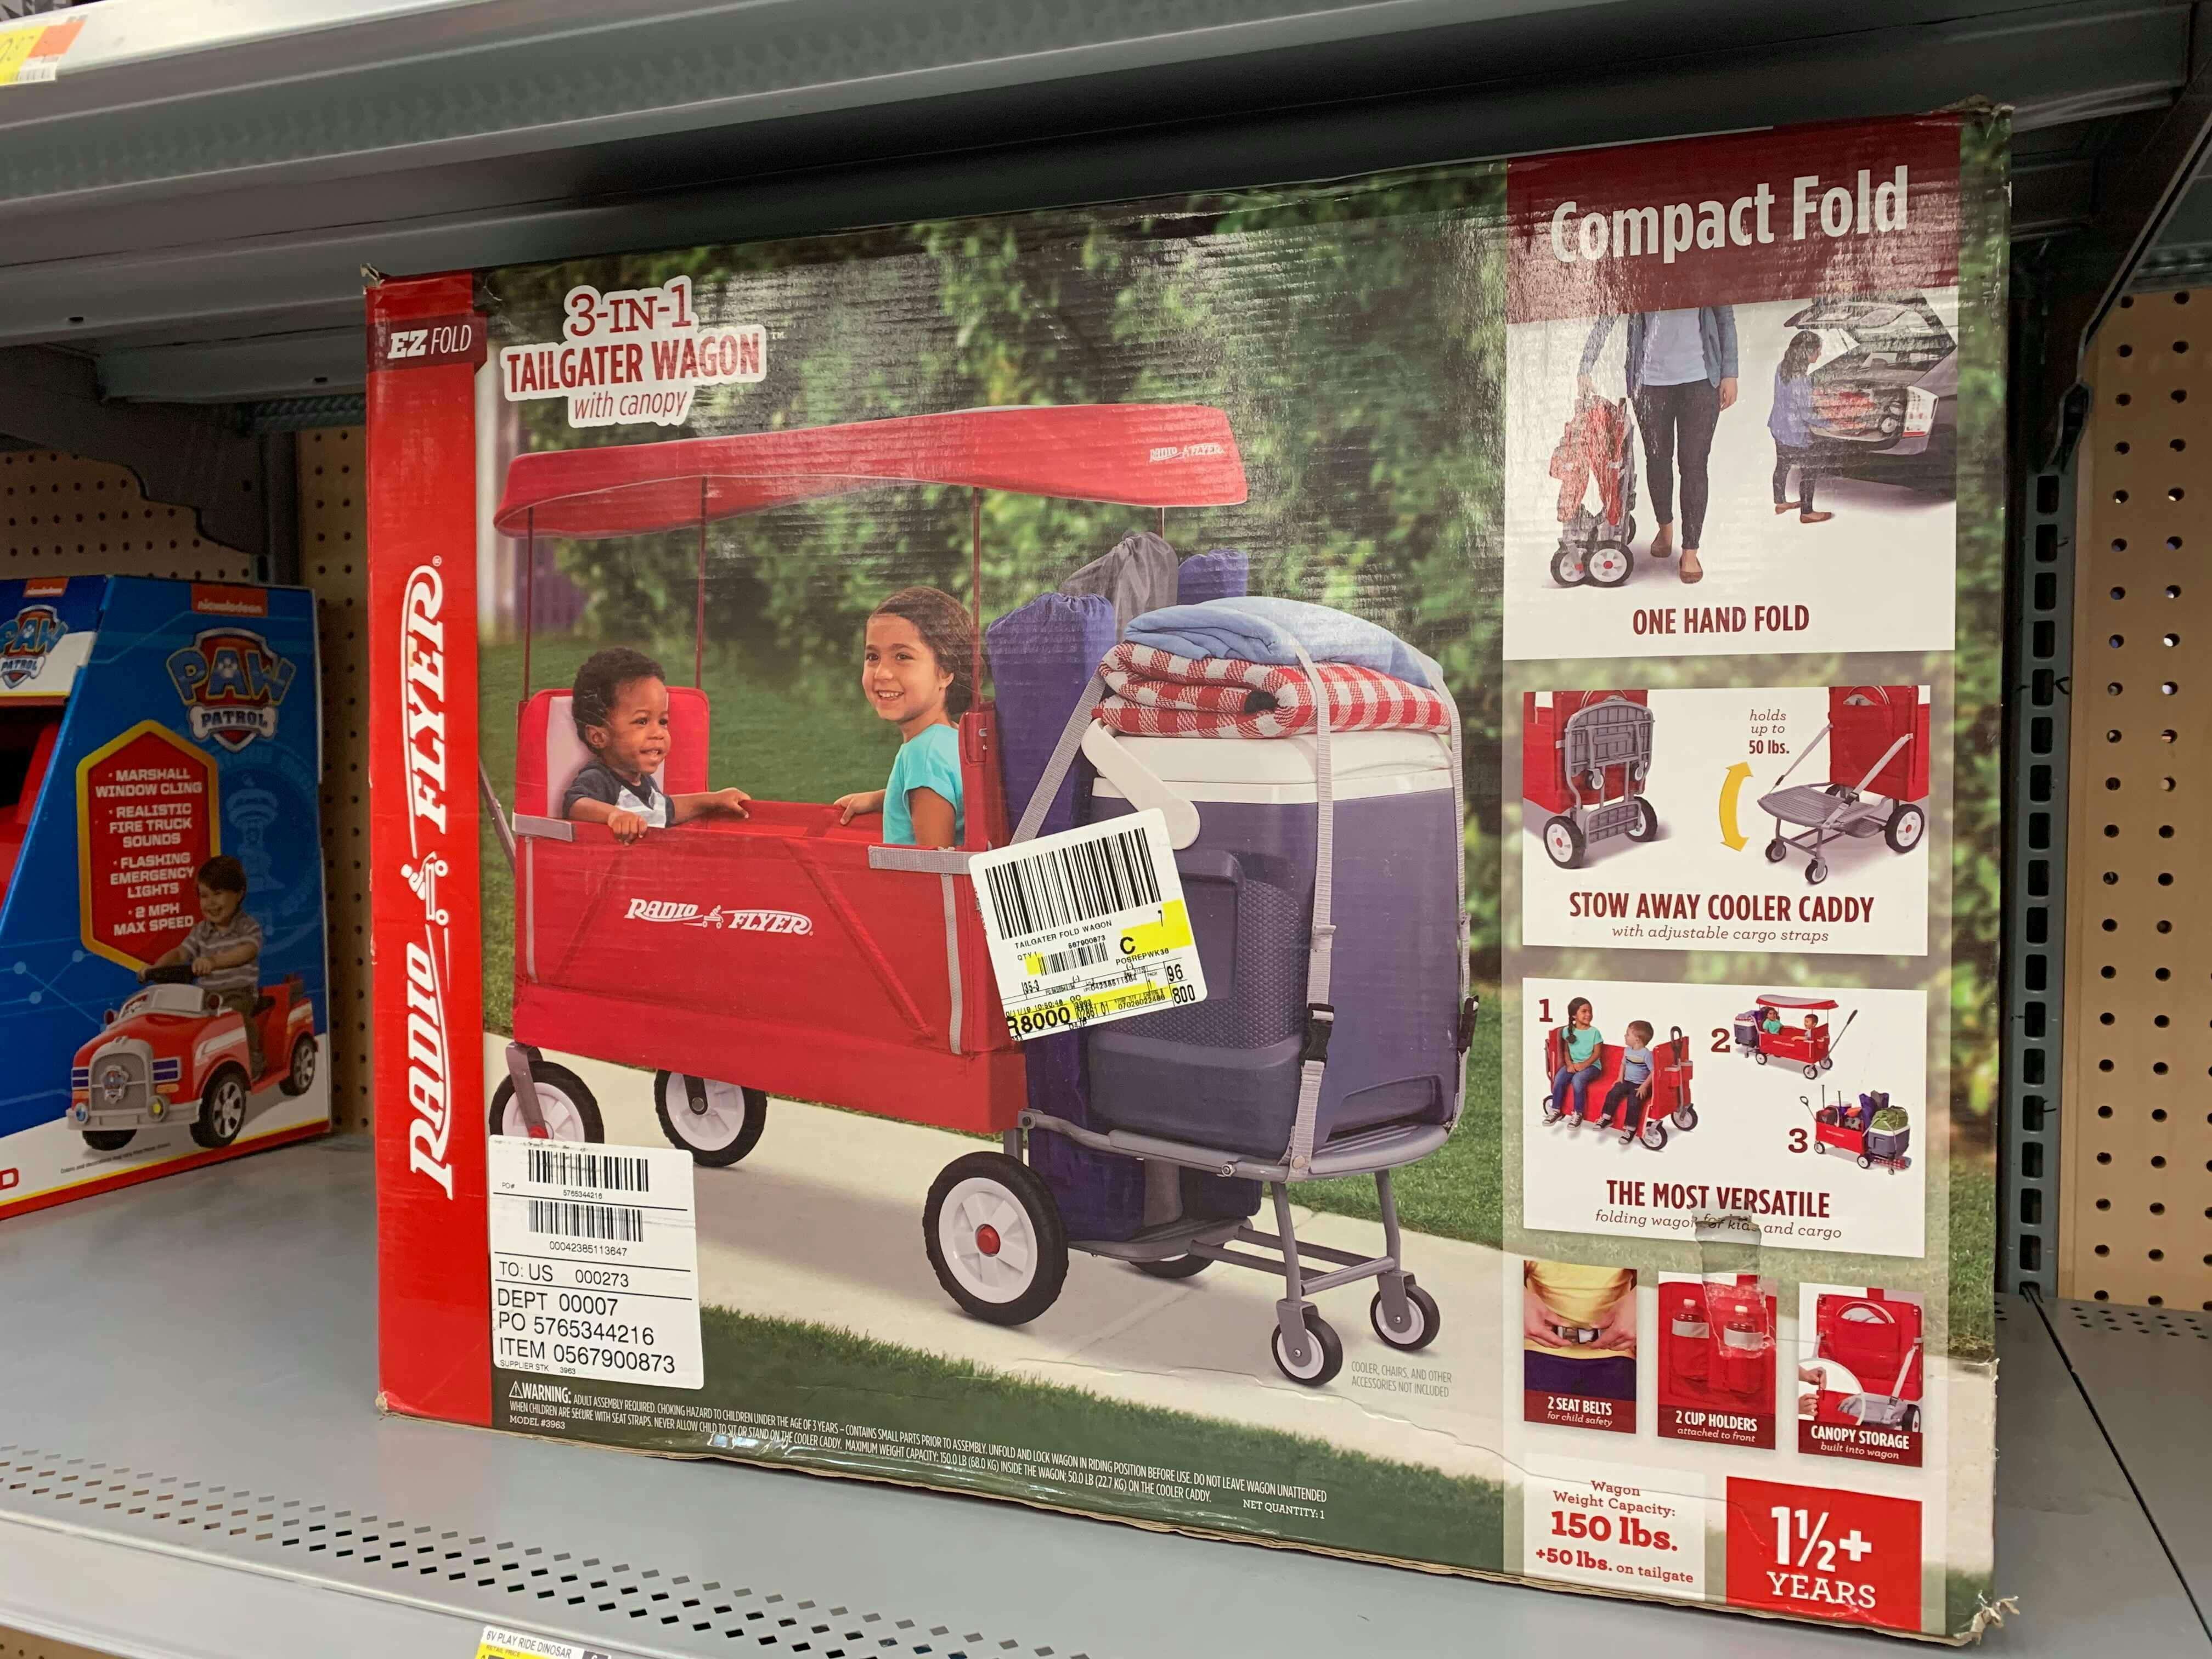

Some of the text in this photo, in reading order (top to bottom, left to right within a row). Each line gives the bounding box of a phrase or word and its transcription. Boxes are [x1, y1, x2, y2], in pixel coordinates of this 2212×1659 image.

[1550, 165, 1908, 264] Compact Fold
[571, 284, 692, 337] 3-IN-1
[387, 324, 471, 359] EZ FOLD
[507, 333, 760, 393] TAILGATER WAGON
[574, 390, 687, 426] with canopy
[1633, 605, 1809, 635] ONE HAND FOLD
[1, 657, 38, 673] PATROL
[166, 646, 296, 706] PAW
[201, 710, 268, 726] PATROL
[1750, 709, 1787, 722] holds
[1751, 723, 1786, 737] up to
[1749, 739, 1790, 755] 50 lbs.
[116, 768, 190, 781] MARSHALL
[95, 782, 202, 798] WINDOW CLING
[116, 803, 192, 819] REALISTIC
[109, 817, 193, 834] FIRE TRUCK
[123, 833, 181, 848] SOUNDS
[120, 852, 190, 870] FLASHING
[110, 866, 194, 885] EMERGENCY
[400, 563, 453, 1201] RADIO FLYER
[127, 882, 179, 899] LIGHTS
[136, 902, 179, 918] 2 MPH
[624, 898, 812, 935] RADIO FLYER
[1570, 892, 1875, 923] STOW AWAY COOLER CADDY
[114, 915, 194, 936] MAX SPEED
[1014, 920, 1112, 949] TAILGATER FOLD WAGON
[1612, 925, 1830, 944] with adjustable cargo straps
[1017, 952, 1032, 961] QTY
[1120, 937, 1136, 955] C
[1167, 963, 1184, 982] 96
[1172, 984, 1196, 1004] 800
[1539, 999, 1554, 1023] 1
[1710, 1028, 1731, 1053] 2
[1788, 1128, 1808, 1153] 3
[1607, 1180, 1830, 1218] THE MOST VERSATILE
[1595, 1209, 1647, 1227] folding
[1764, 1222, 1794, 1235] and
[1798, 1227, 1842, 1241] cargo
[549, 1241, 627, 1257] 00042385113647
[499, 1261, 629, 1287] TO: US 000273
[498, 1288, 618, 1316] DEPT 00007
[499, 1312, 654, 1345] PO 5765344216
[500, 1338, 675, 1374] ITEM 0567900873
[500, 1360, 534, 1370] SUPPLIER
[535, 1363, 549, 1372] STK
[1352, 1361, 1452, 1383] COOLER, CHAIRS, AND OTHER
[1352, 1376, 1449, 1397] ACCESSORIES NOT INCLUDED
[1548, 1396, 1612, 1416] 2 SEAT BELTS
[510, 1415, 565, 1430] MODEL #3963
[522, 1382, 988, 1454] WARNING: ADULT ASSEMBLY REQUIRED. CHOKING HAZARD TO CHILDREN UNDER THE AGE OF 3 YEARS CONTAINS SMALL PARTS PRIOR TO ASSEMBLY.
[1547, 1411, 1613, 1427] for child safety
[1675, 1409, 1758, 1432] 2 CUP HOLDERS
[1677, 1426, 1756, 1442] attached to front
[1811, 1425, 1910, 1450] CANOPY STORAGE
[1820, 1441, 1900, 1460] built into wagon
[1591, 1480, 1641, 1497] Wagon
[1243, 1499, 1325, 1520] NET QUANTITY: 1
[1553, 1490, 1676, 1519] Weight Capacity:
[1551, 1510, 1678, 1553] 150 lbs.
[1536, 1547, 1694, 1584] +50 lbs. on tailgate
[1765, 1571, 1876, 1609] YEARS
[486, 1630, 572, 1658] 6V PLAY RIDE DINOSAR
